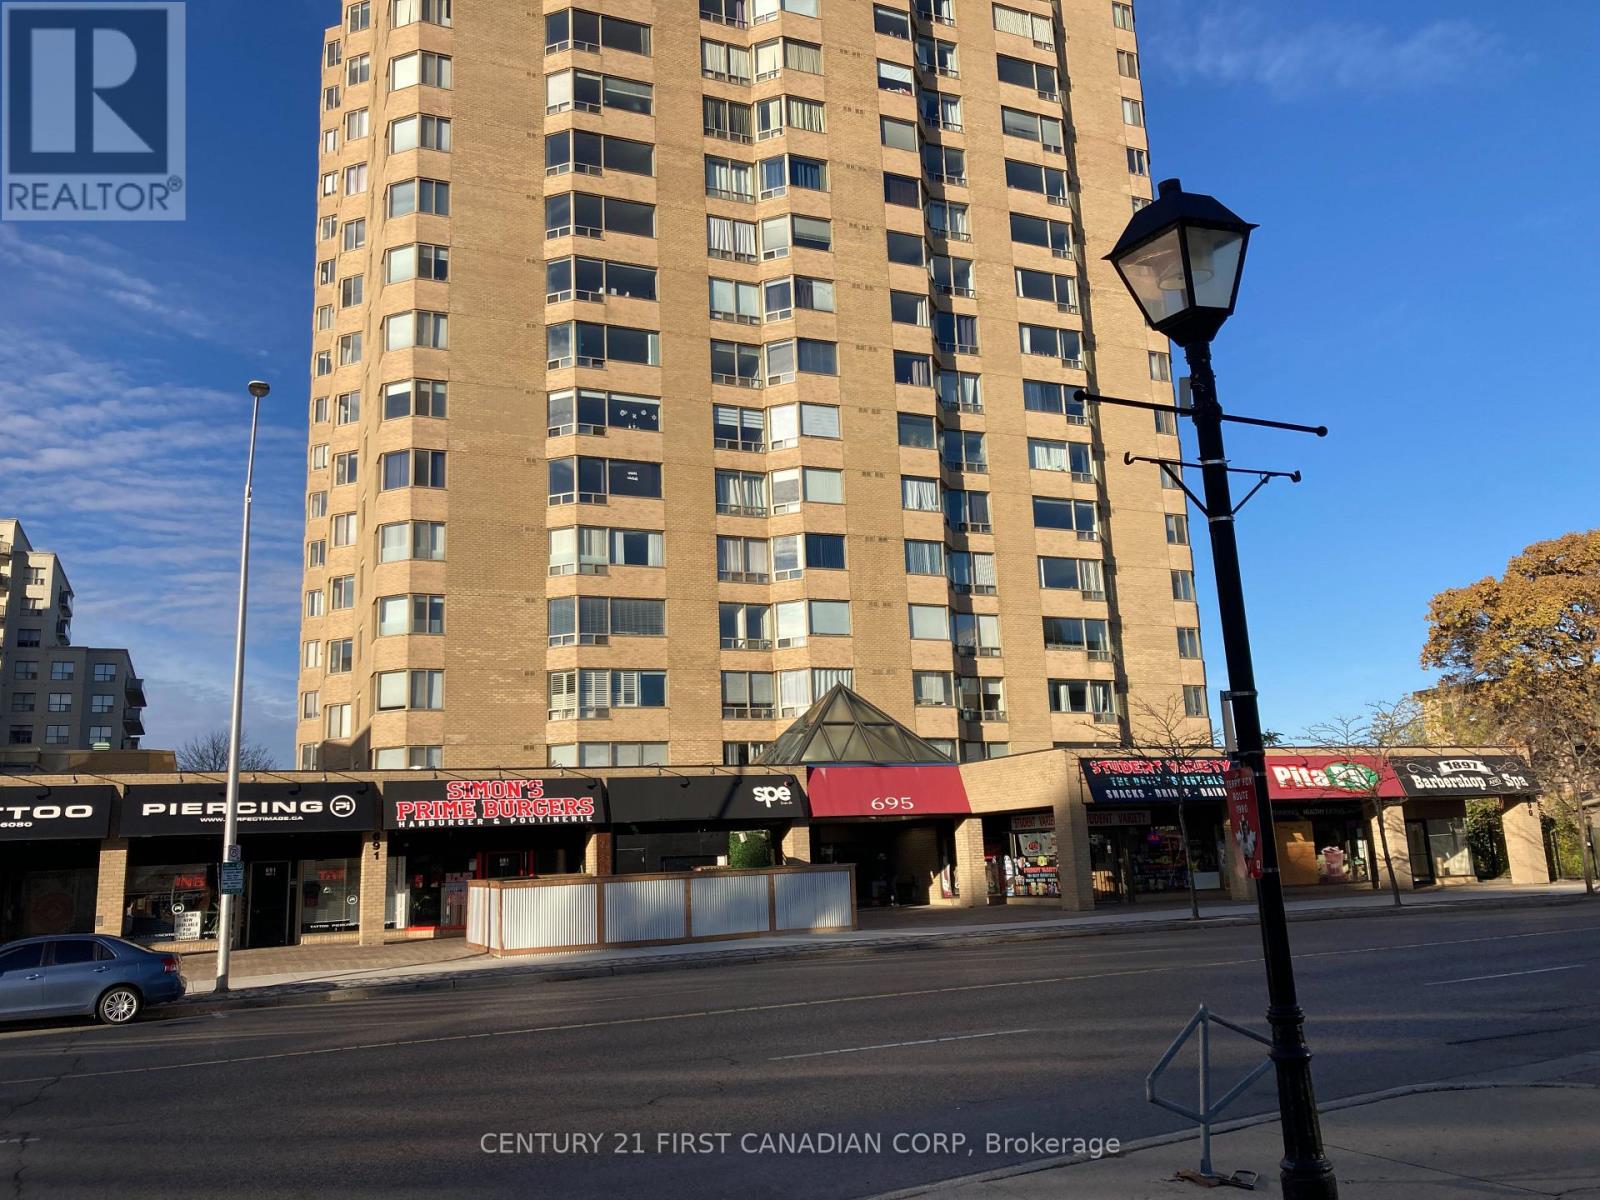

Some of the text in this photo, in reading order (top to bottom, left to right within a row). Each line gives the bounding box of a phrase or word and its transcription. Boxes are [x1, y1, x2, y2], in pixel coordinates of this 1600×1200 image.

[1090, 760, 1230, 775] STUDENT VARIETY
[1445, 760, 1479, 770] 1897
[1271, 765, 1331, 788] Pita
[1411, 774, 1487, 790] Barbershop
[1501, 773, 1529, 789] Spa
[446, 780, 544, 800] SIMON'S
[1105, 789, 1145, 799] SNACKS
[1155, 788, 1191, 798] DRINS
[142, 801, 323, 816] PIERCING
[396, 797, 595, 821] PRIME BURGERS
[871, 797, 914, 811] 695
[398, 815, 593, 828] HAMBURGER & POUTINERIE
[372, 831, 380, 860] 691
